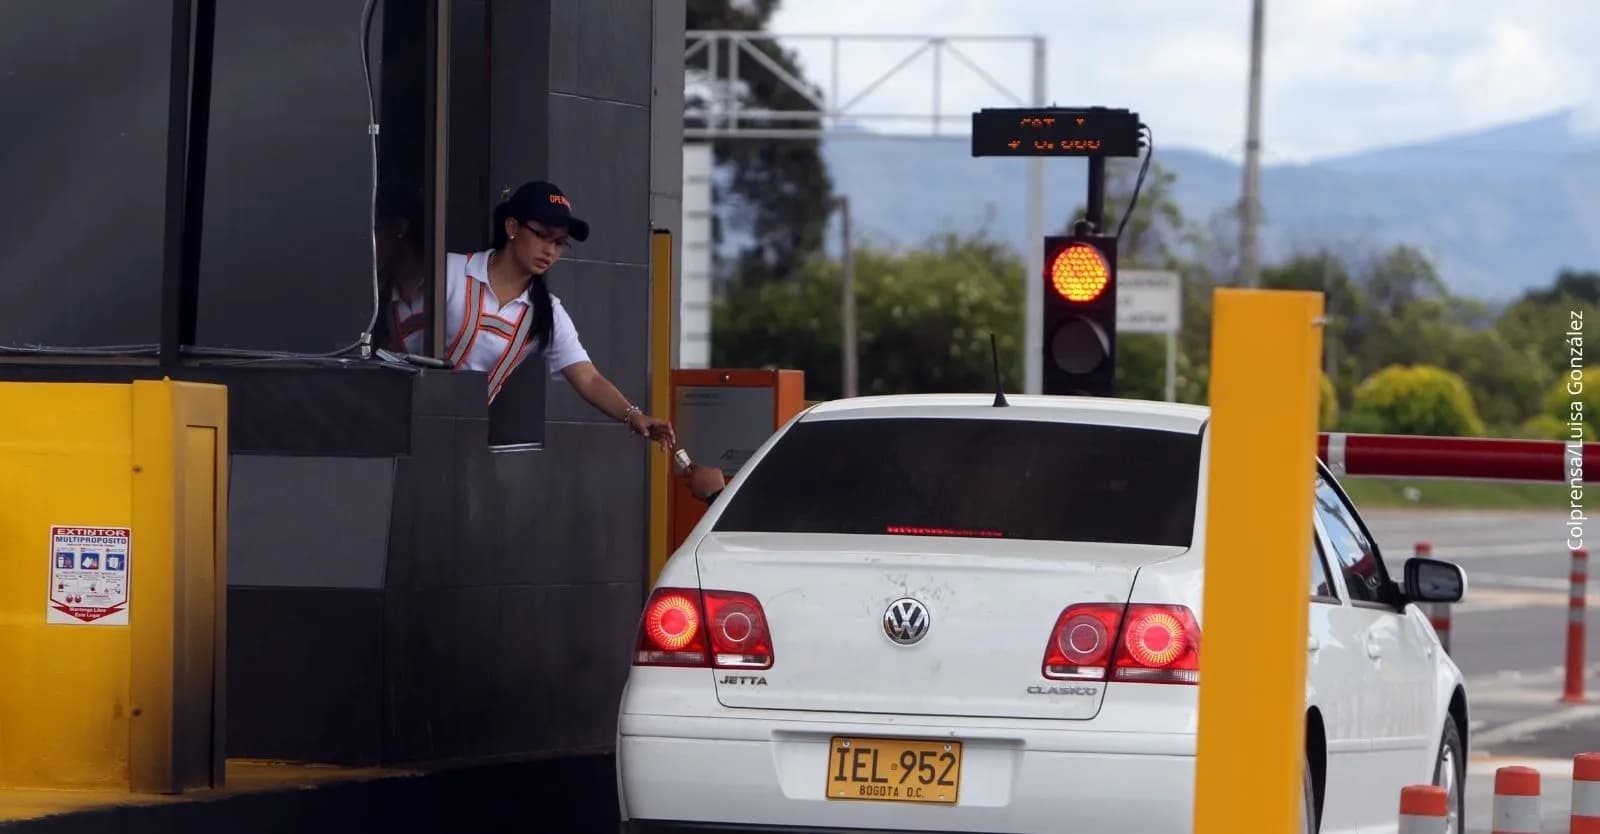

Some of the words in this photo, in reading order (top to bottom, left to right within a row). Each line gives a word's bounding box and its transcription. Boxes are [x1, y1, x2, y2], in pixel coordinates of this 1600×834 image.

[57, 528, 127, 537] EXTINTOR
[55, 536, 127, 545] MULTIPROPOSITO
[719, 675, 768, 686] JETTA
[1026, 685, 1097, 696] CLASICO
[834, 747, 889, 783] IEL
[898, 750, 956, 786] 952
[859, 784, 899, 798] BOGOTA
[906, 786, 925, 799] D.C.
